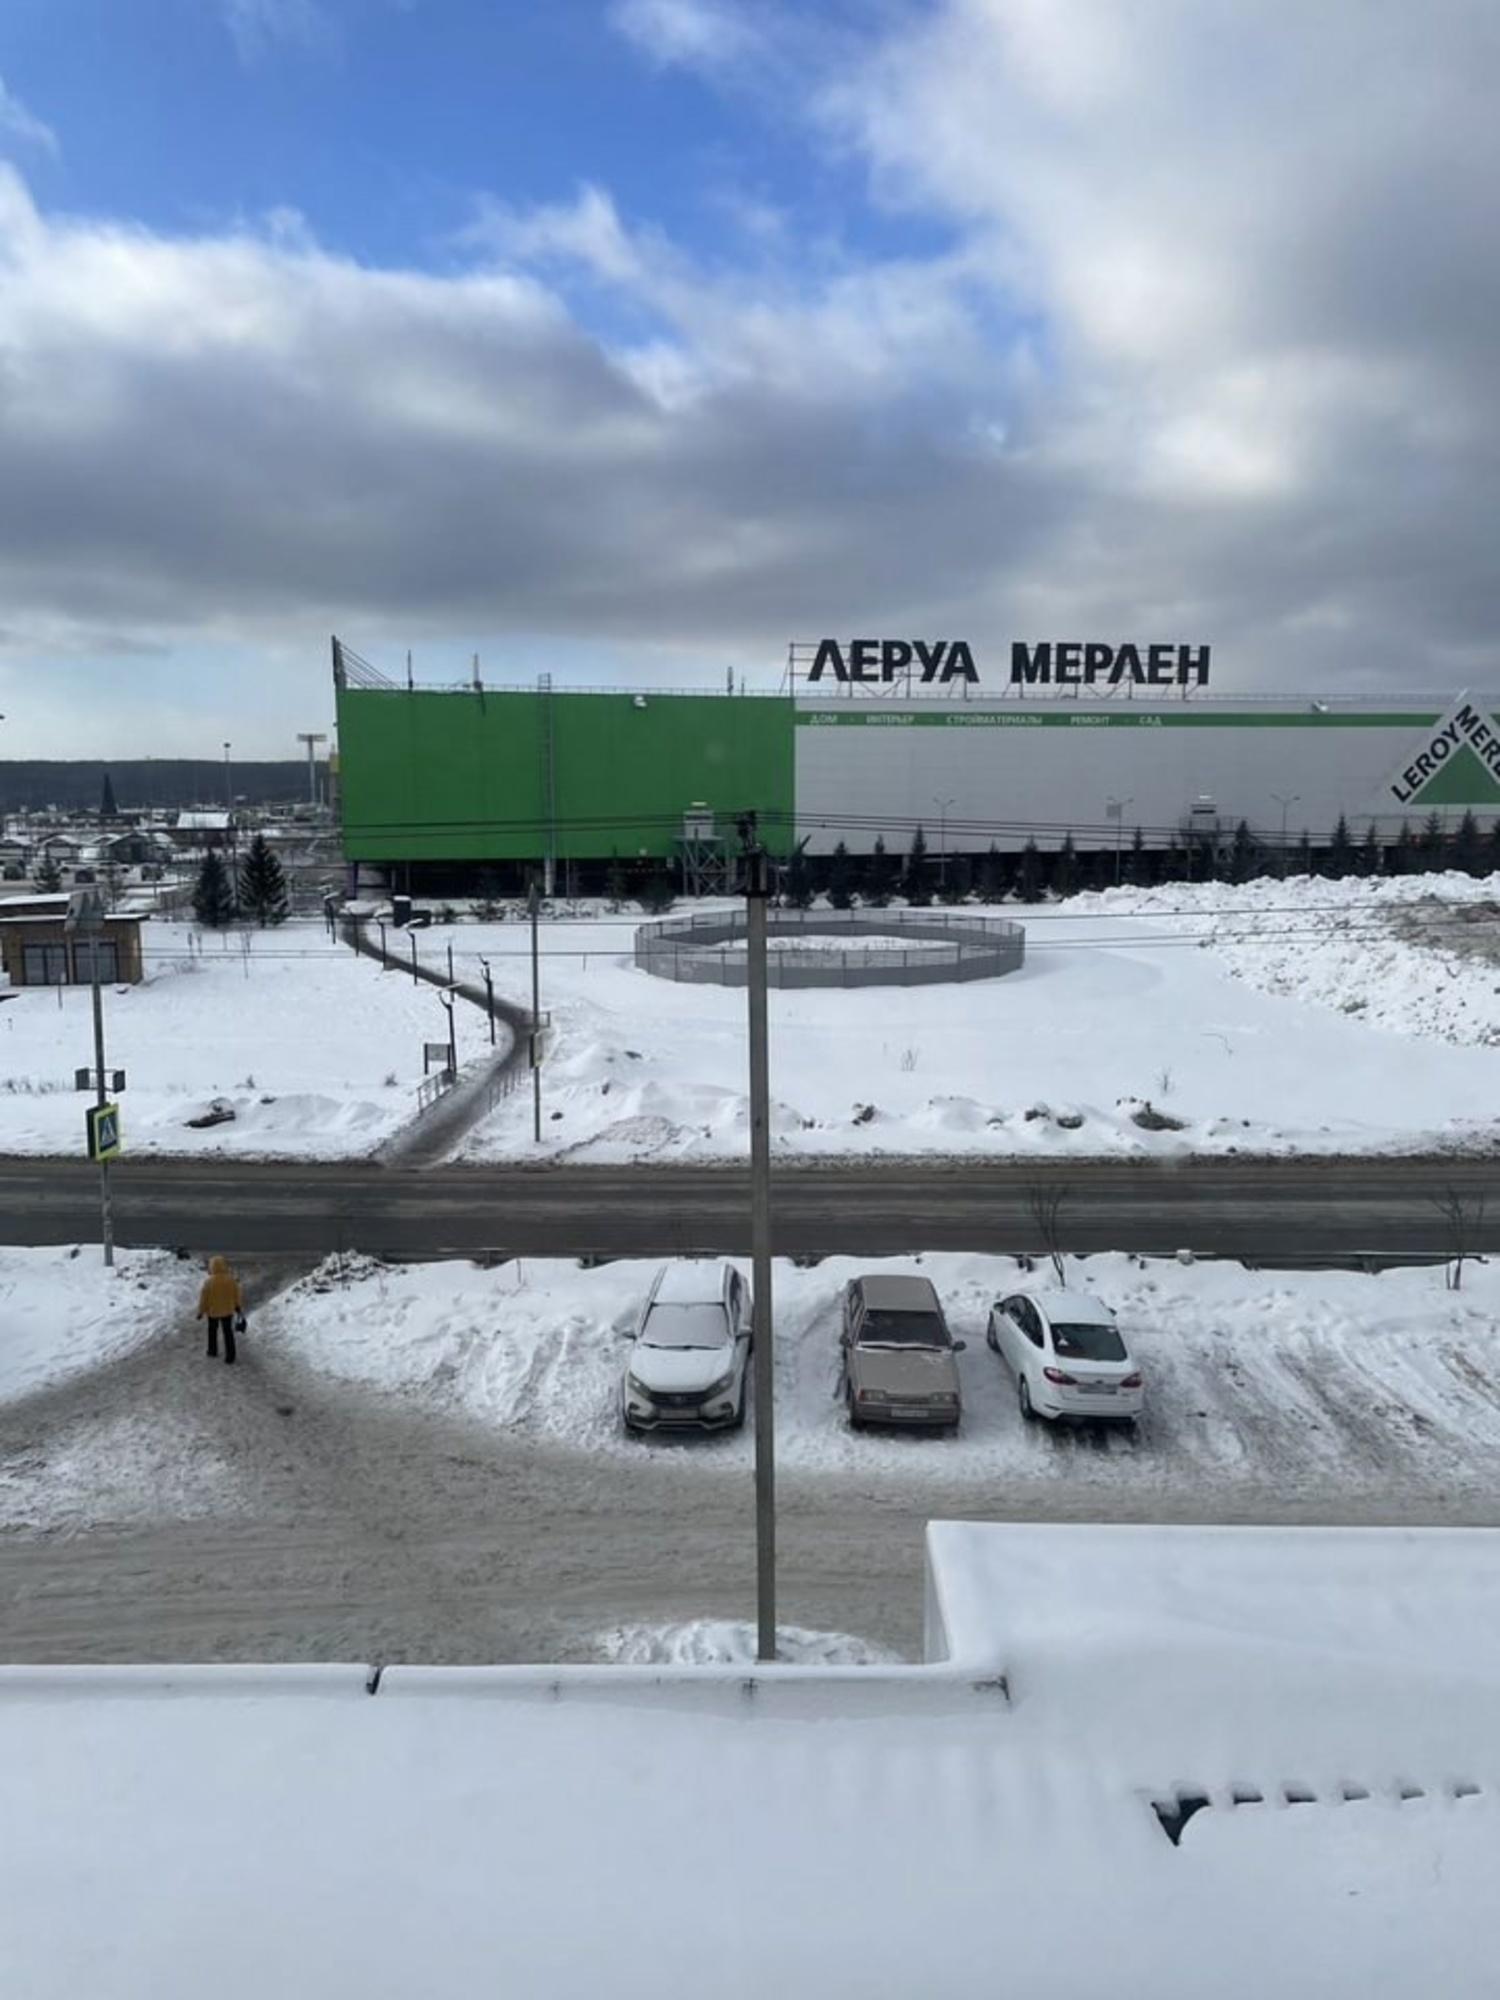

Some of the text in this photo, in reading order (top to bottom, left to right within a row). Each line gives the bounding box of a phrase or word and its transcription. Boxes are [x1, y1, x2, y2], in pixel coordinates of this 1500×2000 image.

[807, 639, 1211, 685] ЛЕРУА МЕРЛЕН
[809, 714, 1163, 726] ДОМ ИНТЕРЬЕР СТРОЙМАТЕРИАЛЫ РЕМОНТ САД
[1391, 722, 1460, 803] LEROY
